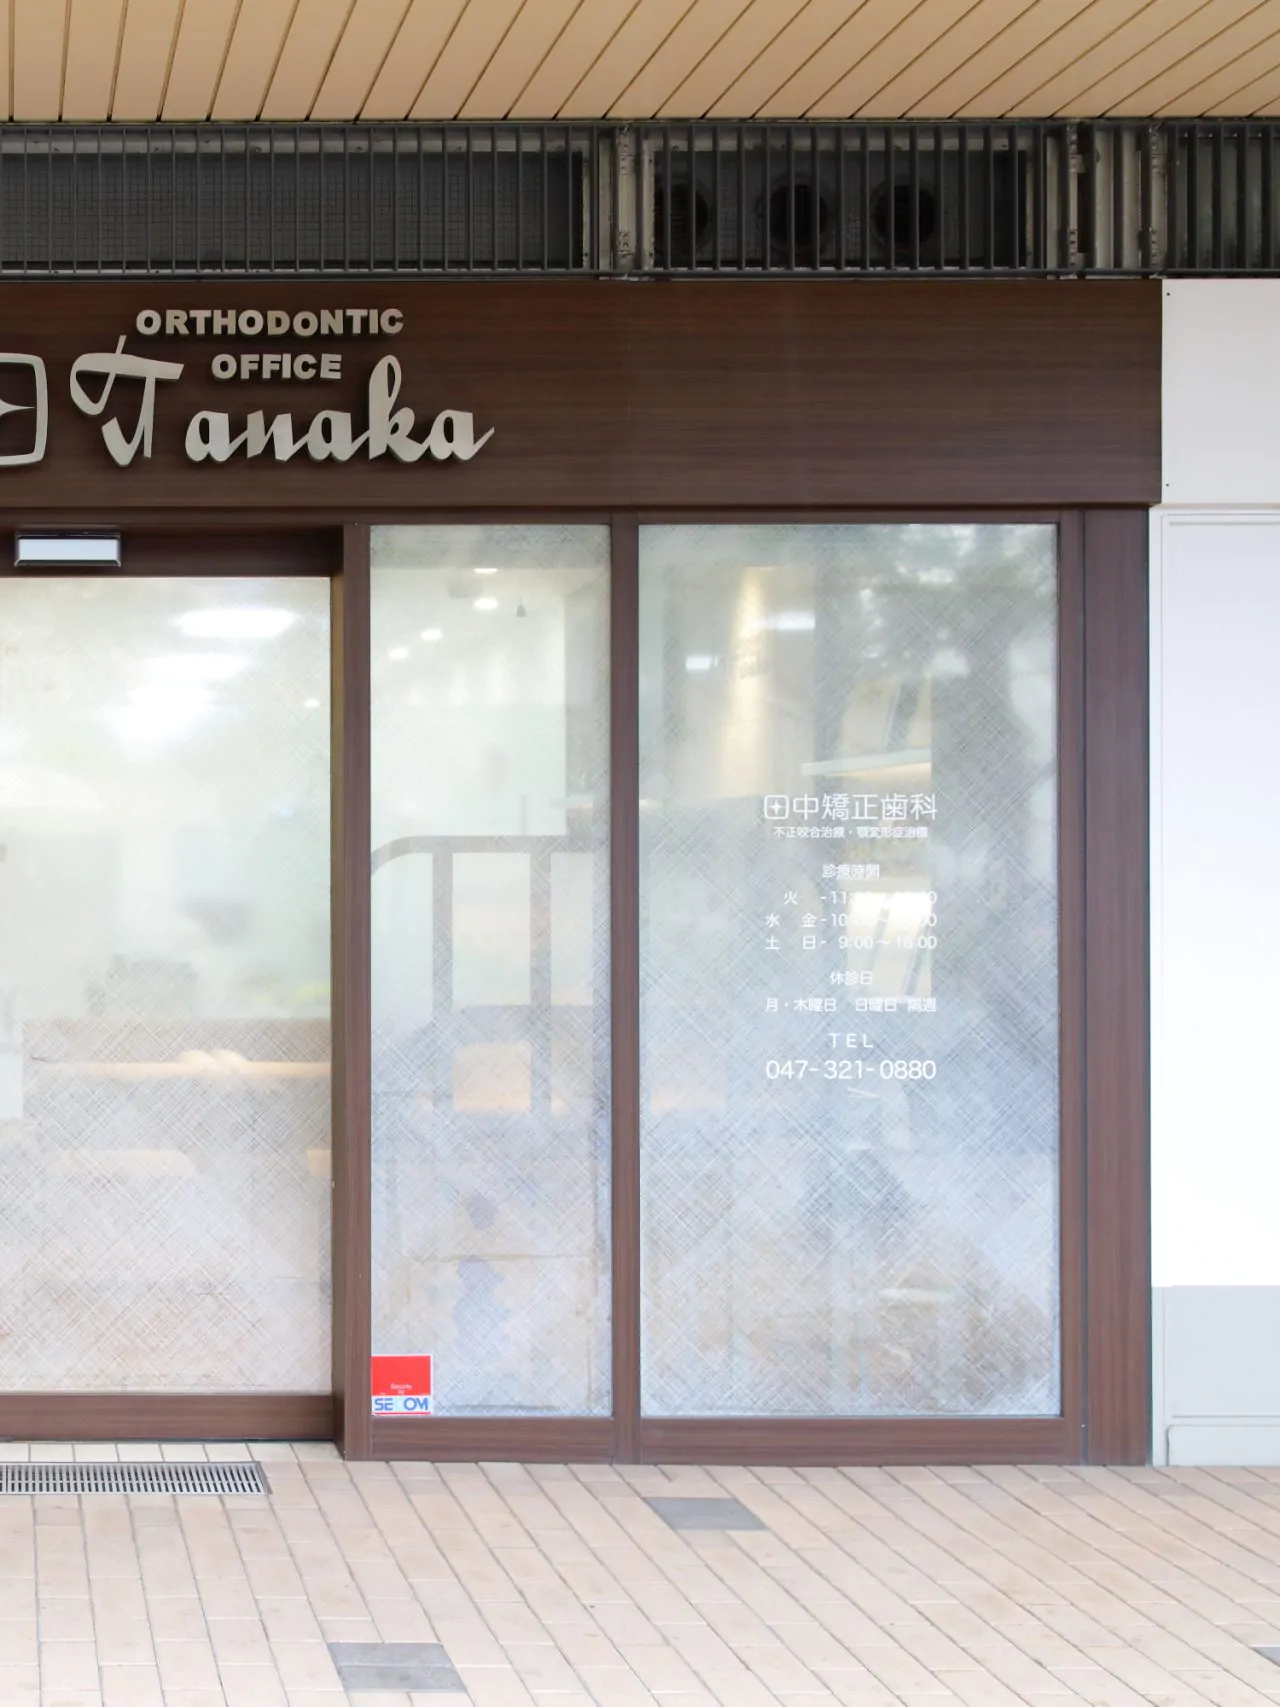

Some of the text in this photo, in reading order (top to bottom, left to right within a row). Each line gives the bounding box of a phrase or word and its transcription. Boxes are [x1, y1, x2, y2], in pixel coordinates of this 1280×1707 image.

[135, 309, 405, 336] ORTHODONTIC
[211, 353, 342, 380] OFFICE
[69, 334, 495, 467] Tanaka
[830, 970, 873, 985] 休診日
[828, 1033, 874, 1048] TEL
[766, 1060, 937, 1080] 047-321-0880
[374, 1397, 428, 1411] SEOM
